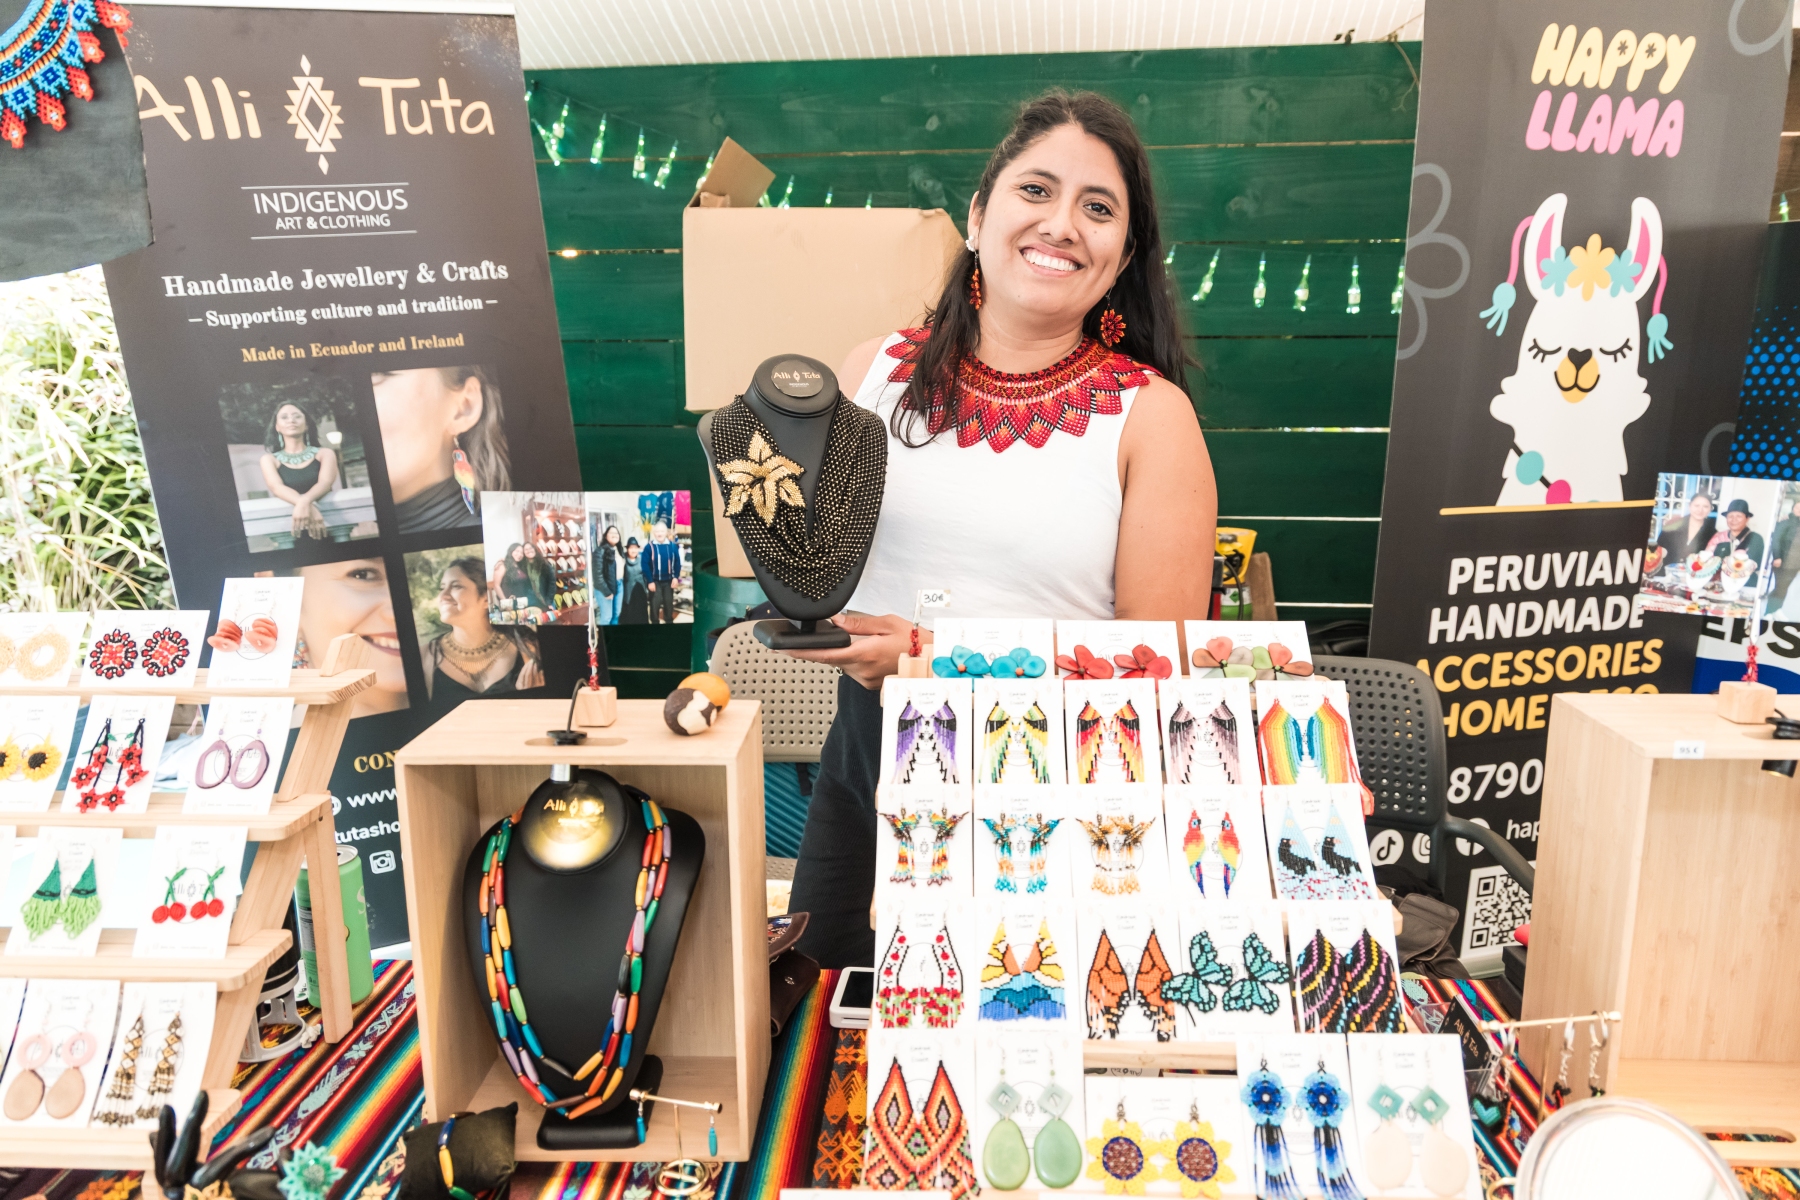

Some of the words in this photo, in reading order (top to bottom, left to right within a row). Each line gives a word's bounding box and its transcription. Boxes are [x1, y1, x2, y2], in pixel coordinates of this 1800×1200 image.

[1531, 23, 1696, 94] HAPPY
[134, 74, 262, 141] Alli
[358, 77, 495, 136] Tuta
[1526, 90, 1684, 157] LLAMA
[253, 188, 409, 214] INDIGENOUS
[275, 217, 303, 230] ART
[306, 217, 318, 230] &
[319, 213, 391, 229] CLOTHING
[162, 269, 294, 297] Handmade
[301, 265, 409, 290] Jewellery
[416, 263, 436, 285] &
[442, 260, 509, 282] Crafts
[206, 306, 307, 329] Supporting
[311, 301, 373, 320] culture
[377, 299, 409, 317] and
[412, 295, 483, 315] tradition
[241, 345, 286, 363] Made
[290, 344, 306, 359] in
[310, 340, 375, 359] Ecuador
[379, 336, 406, 353] and
[410, 332, 465, 351] Ireland
[1448, 548, 1643, 595] PERUVIAN
[1428, 595, 1645, 644] HANDMADE
[1446, 758, 1544, 803] 8790
